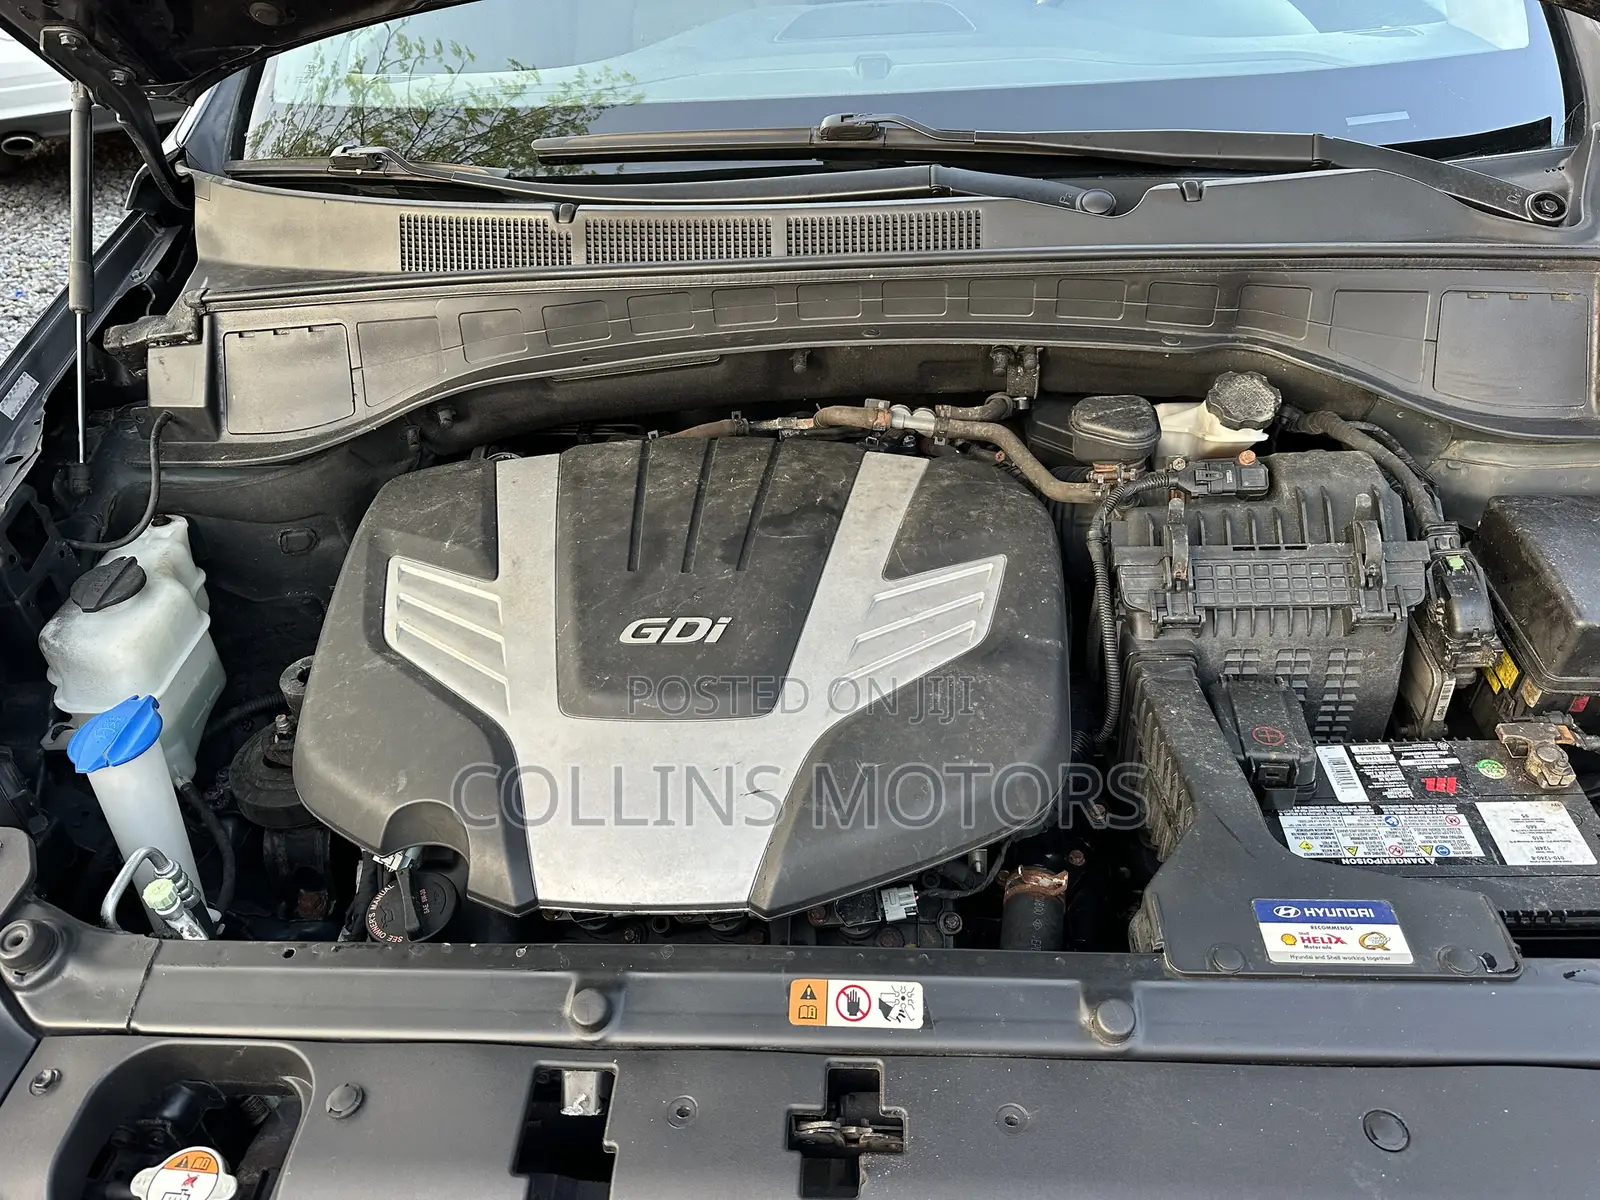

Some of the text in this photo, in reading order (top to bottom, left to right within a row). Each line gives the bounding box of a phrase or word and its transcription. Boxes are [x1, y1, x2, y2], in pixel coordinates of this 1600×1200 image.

[619, 616, 734, 646] GDi
[1341, 857, 1425, 865] DANGER/POISON
[370, 884, 395, 910] MANUAL
[1304, 907, 1375, 918] HYUNDAI
[387, 935, 403, 943] SEE
[1300, 935, 1347, 945] HELIX
